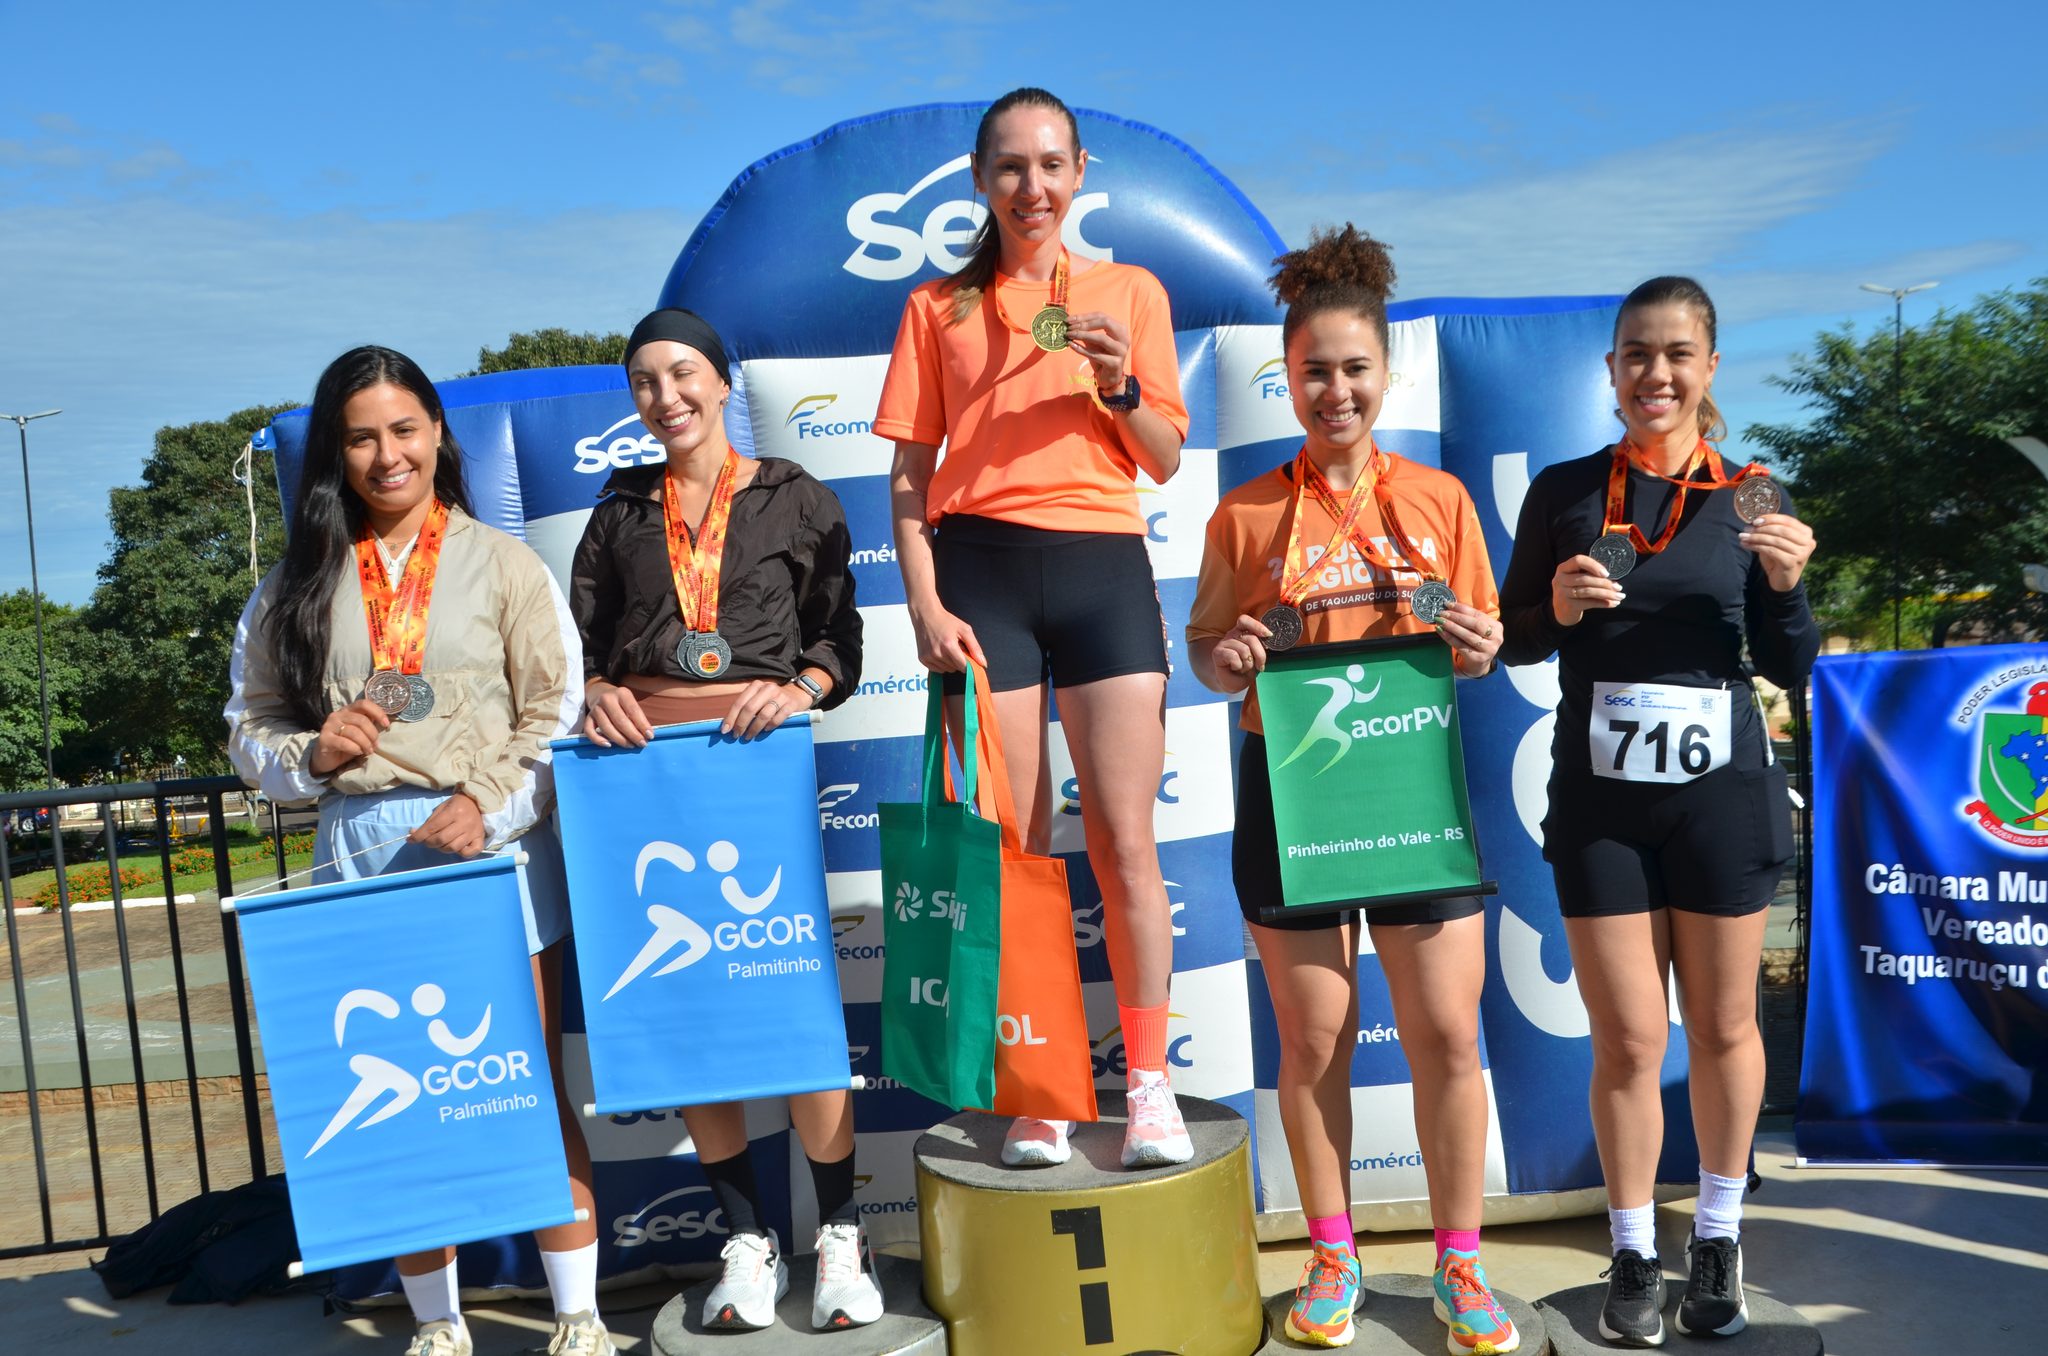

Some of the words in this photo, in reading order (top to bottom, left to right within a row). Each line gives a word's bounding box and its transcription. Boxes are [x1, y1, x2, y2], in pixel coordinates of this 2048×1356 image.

[842, 192, 1114, 281] Sec
[1384, 591, 1398, 600] DO
[1401, 590, 1414, 598] SU
[1957, 685, 1992, 724] PODER
[1991, 664, 2048, 688] LEGISLA
[1351, 704, 1452, 739] acorPV
[1608, 719, 1711, 775] 716
[1287, 838, 1374, 859] Pinheirinho
[1377, 834, 1396, 849] do
[1399, 830, 1432, 847] Vale
[1444, 827, 1465, 841] RS
[1864, 863, 1989, 901] Câmara
[1998, 871, 2048, 903] Mu
[714, 914, 818, 951] GCOR
[1922, 907, 2048, 946] Vereado
[727, 957, 821, 979] Palmitinho
[1859, 944, 2027, 991] Taquaruçu
[422, 1050, 532, 1096] GCOR
[439, 1093, 538, 1123] Palmitinho
[1051, 1206, 1114, 1346] 1
